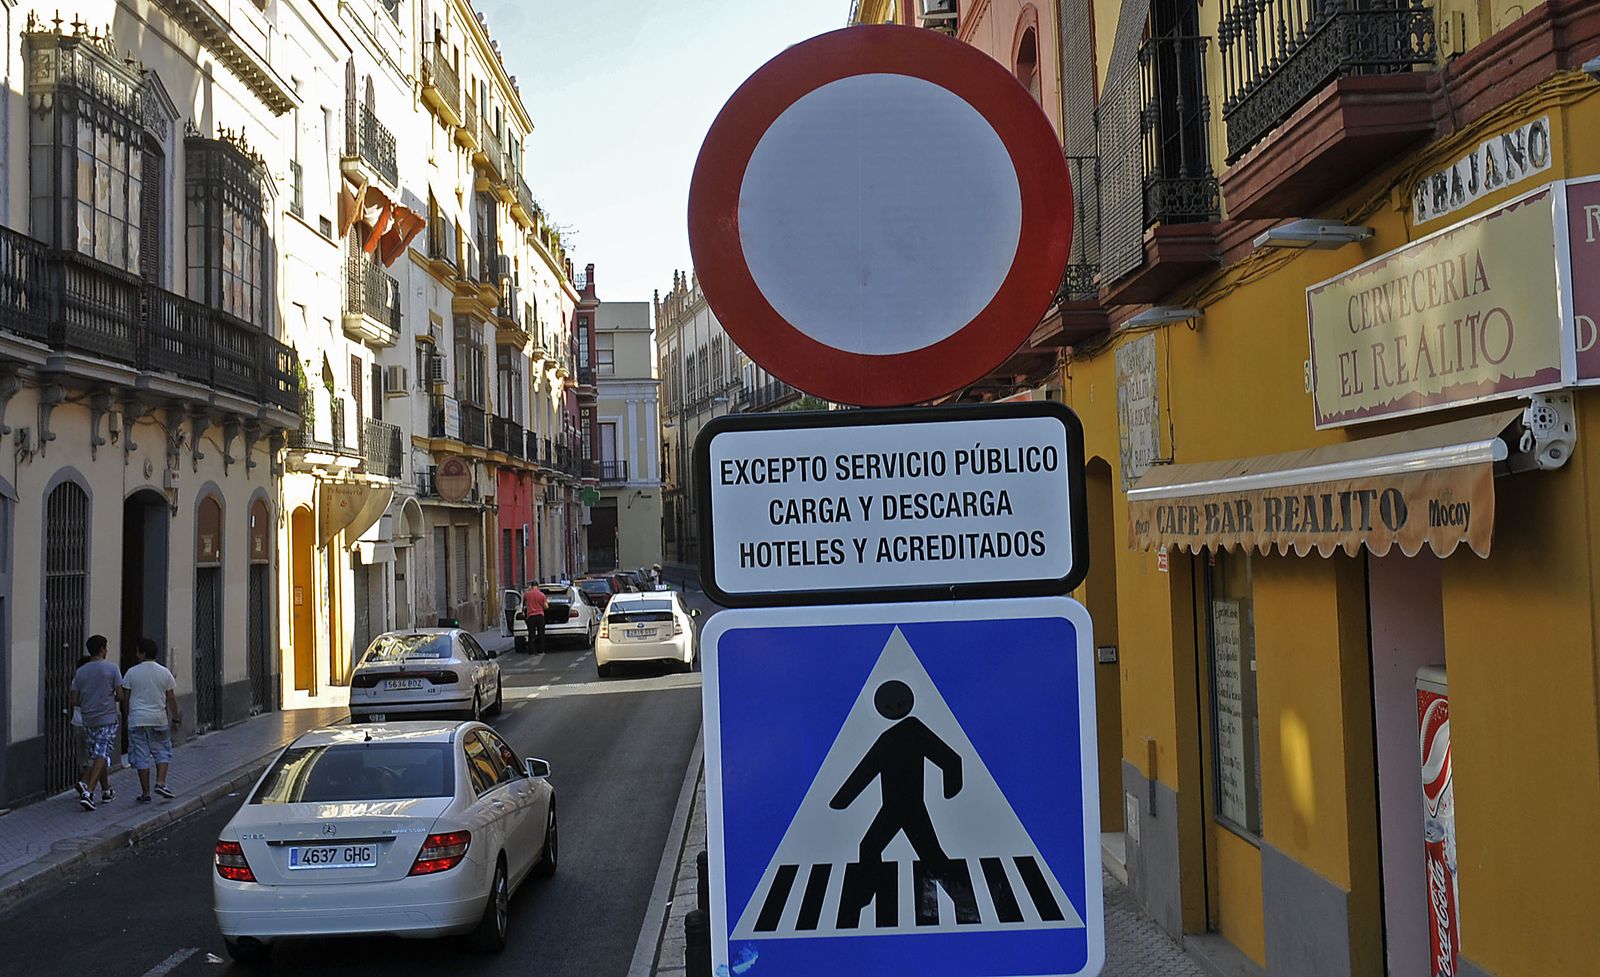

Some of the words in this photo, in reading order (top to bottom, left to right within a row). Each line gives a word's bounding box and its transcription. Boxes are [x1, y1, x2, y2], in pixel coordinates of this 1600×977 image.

[1413, 120, 1549, 222] TRAJANO
[1347, 248, 1491, 335] CERVECERIA
[1338, 349, 1364, 398] EL
[1370, 307, 1514, 391] REALITO
[720, 456, 828, 486] EXCEPTO
[835, 450, 946, 481] SERVICIO
[954, 442, 1059, 476] PÚBLICO
[769, 496, 851, 526] CARGA
[858, 495, 874, 522] Y
[882, 489, 1013, 521] DESCARGA
[1156, 505, 1200, 537] CAFE
[1204, 499, 1254, 535] BAR
[1263, 488, 1409, 534] REALITO
[1428, 498, 1472, 533] Mocay
[739, 538, 846, 569] HOTELES
[852, 537, 868, 564] Y
[876, 530, 1047, 563] ACREDITADOS
[302, 848, 338, 865] 4637
[344, 846, 371, 864] GHG
